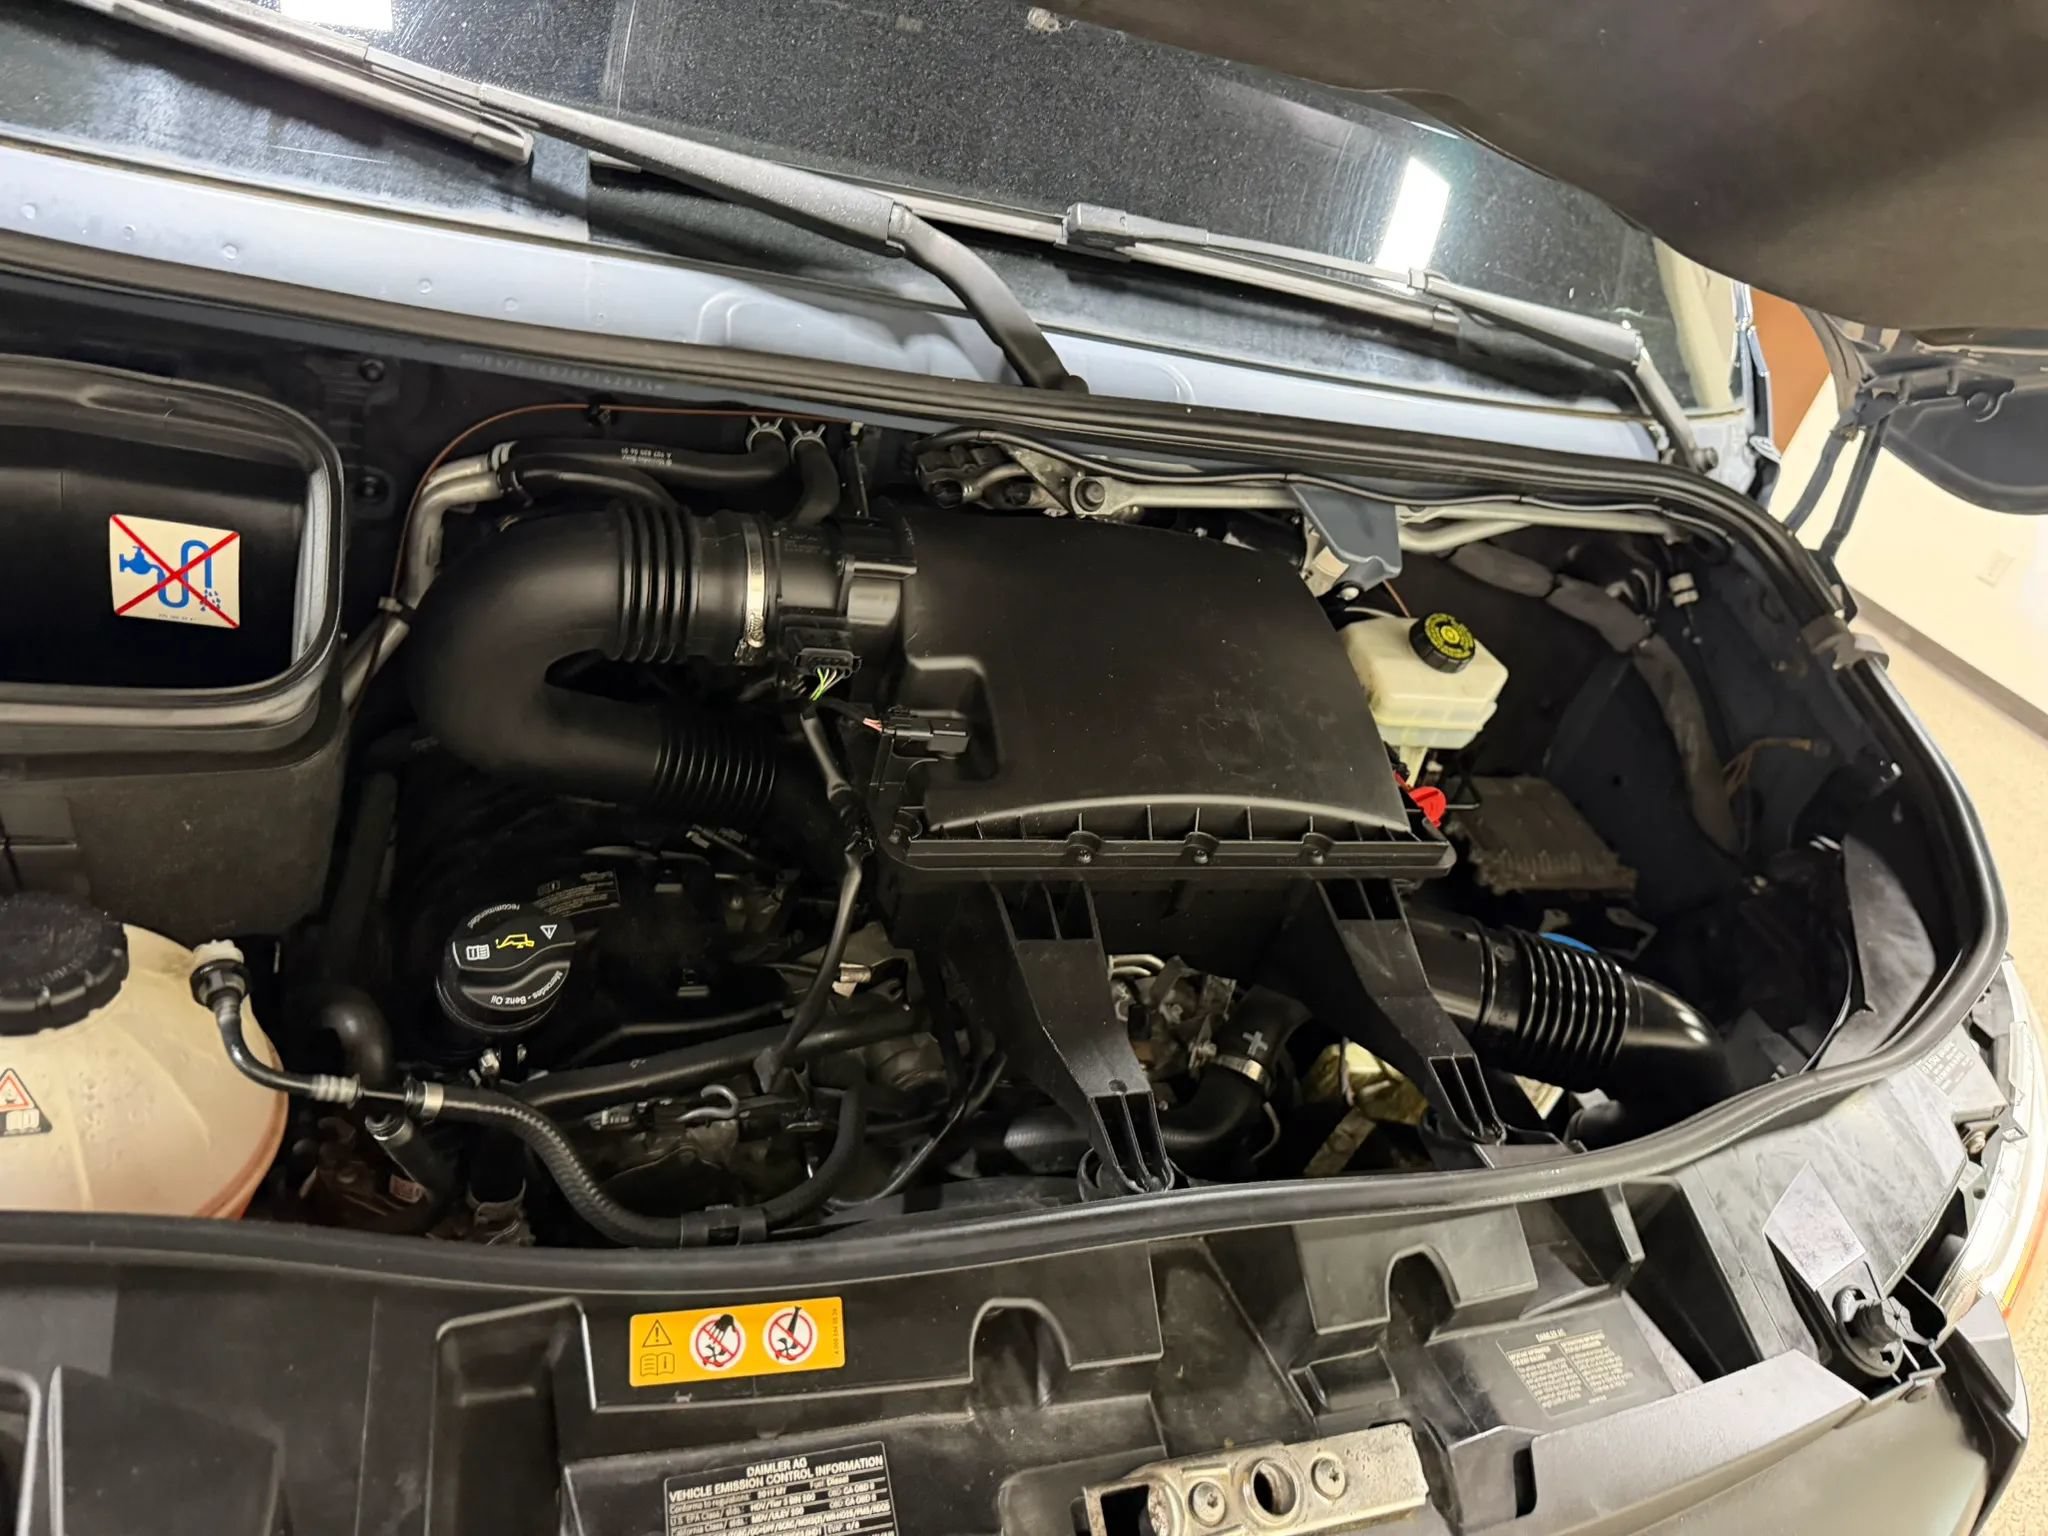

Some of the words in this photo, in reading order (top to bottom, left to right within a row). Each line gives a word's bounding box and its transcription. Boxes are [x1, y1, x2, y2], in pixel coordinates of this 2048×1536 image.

[467, 903, 521, 929] recommended
[531, 970, 564, 999] Mercedes
[490, 994, 504, 1004] Oil
[504, 995, 527, 1005] Benz
[669, 1485, 713, 1503] VEHICLE
[714, 1476, 764, 1495] EMISSION
[765, 1468, 814, 1486] CONTROL
[815, 1455, 883, 1477] INFORMATION
[746, 1460, 791, 1478] DAIMLER
[792, 1457, 808, 1470] AG
